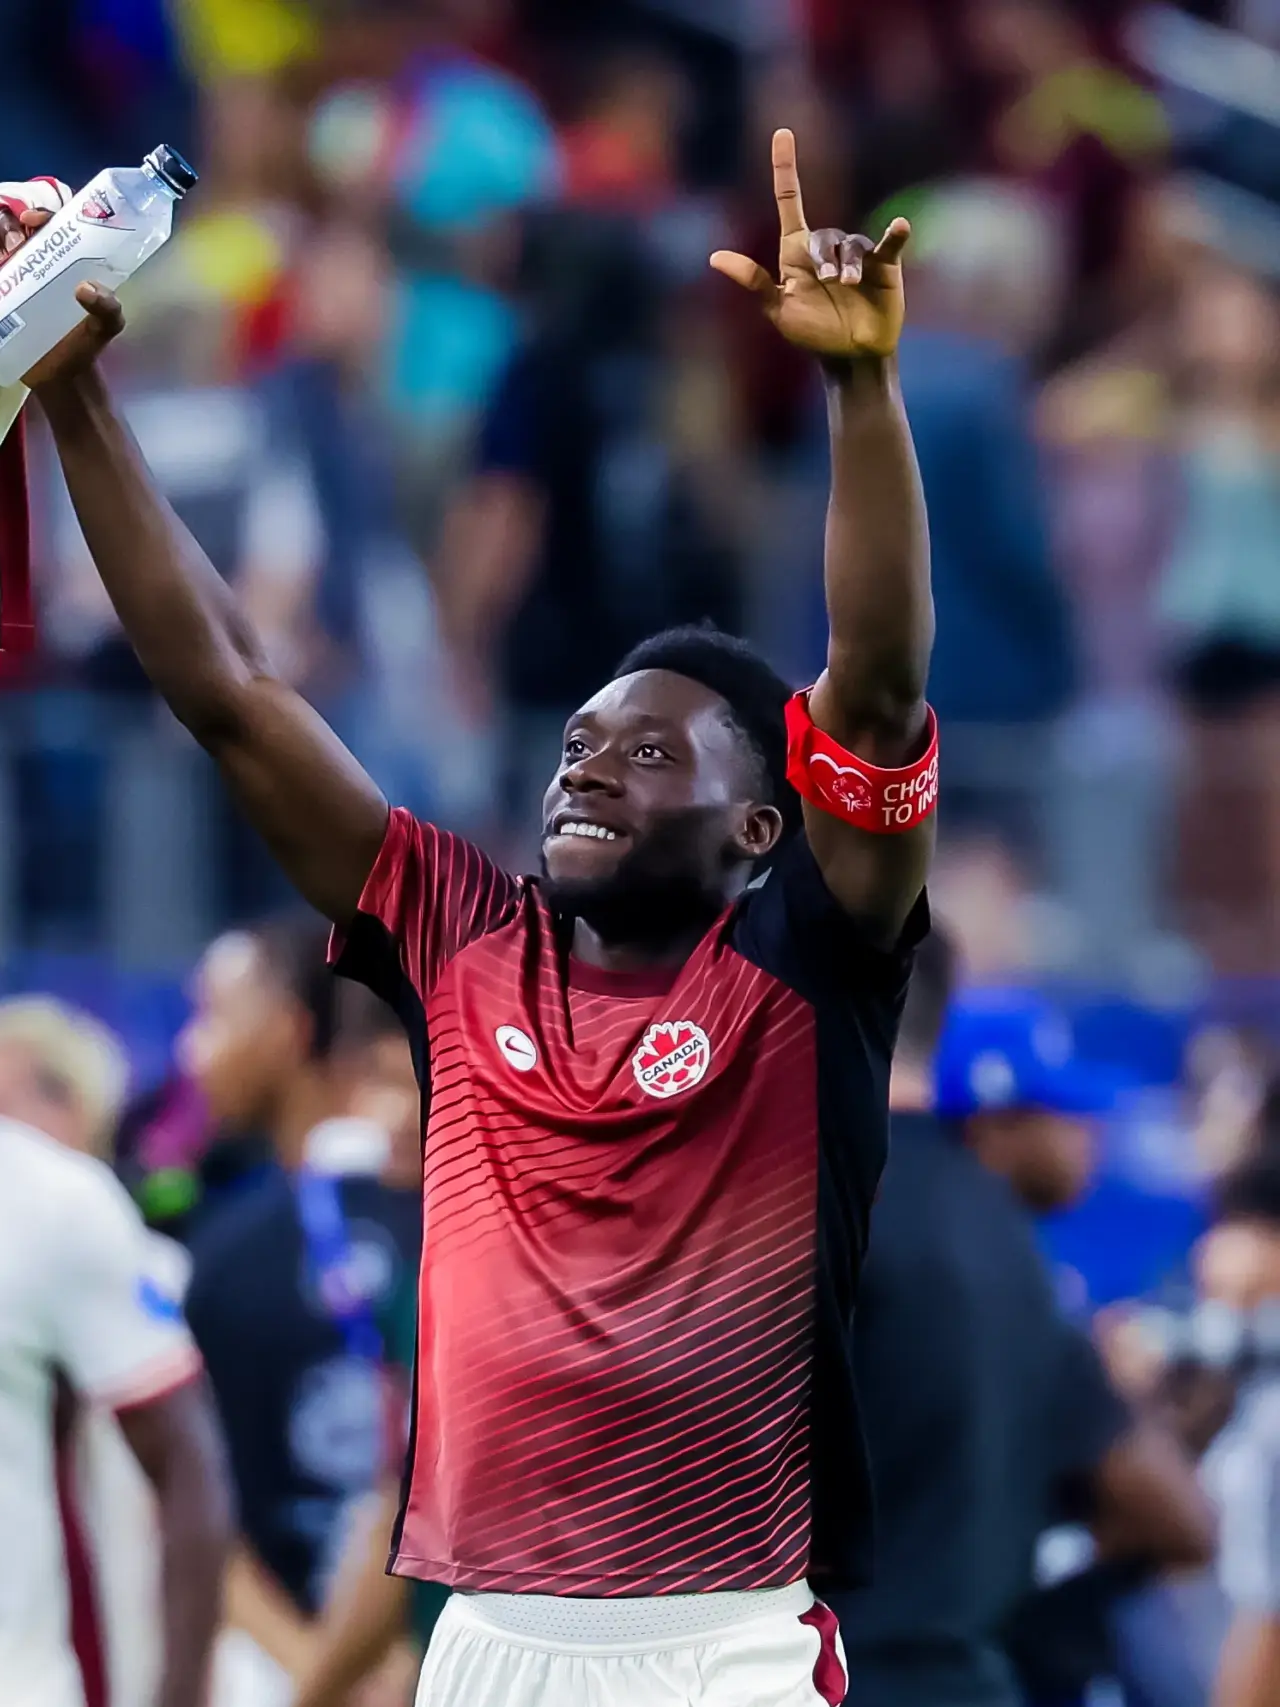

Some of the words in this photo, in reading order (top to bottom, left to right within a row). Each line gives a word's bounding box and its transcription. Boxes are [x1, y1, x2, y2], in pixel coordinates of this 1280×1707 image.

[33, 233, 83, 281] SportWater
[884, 756, 938, 802] CHOO
[881, 804, 913, 826] TO
[642, 1039, 703, 1083] CANADA
